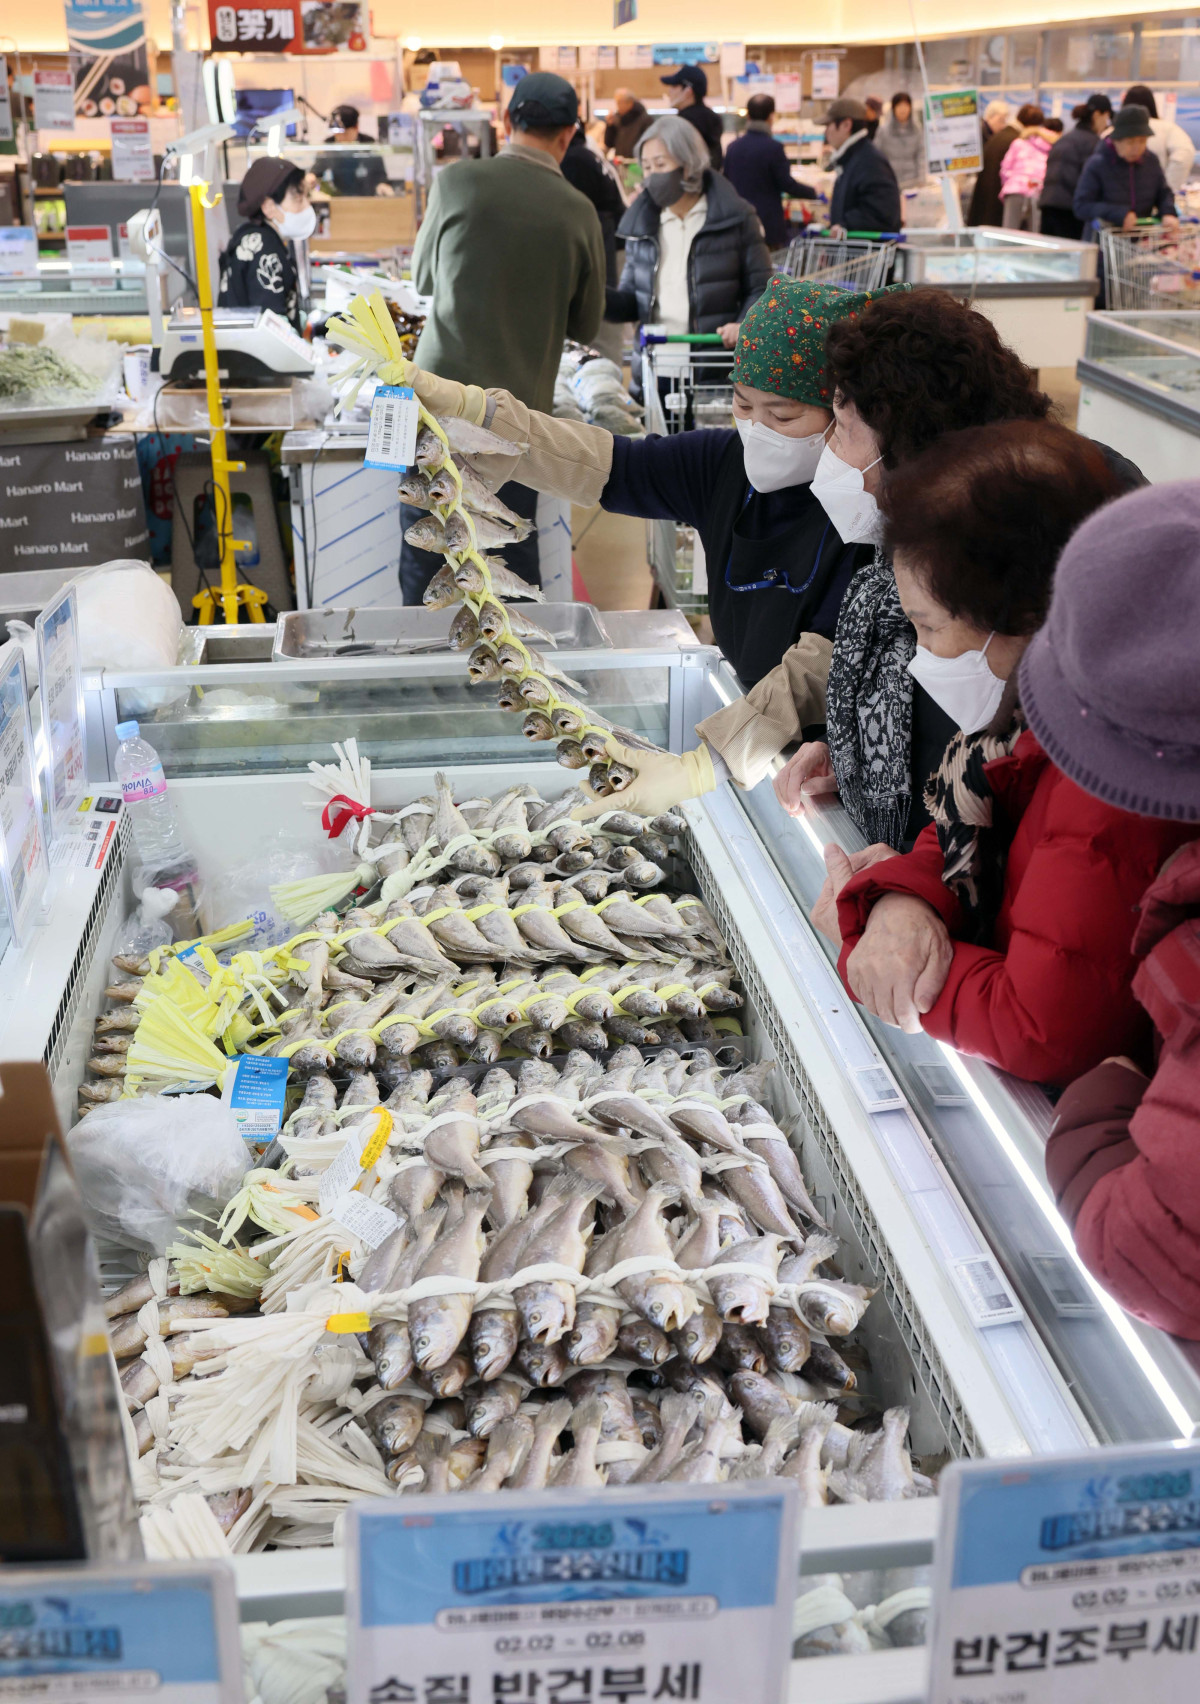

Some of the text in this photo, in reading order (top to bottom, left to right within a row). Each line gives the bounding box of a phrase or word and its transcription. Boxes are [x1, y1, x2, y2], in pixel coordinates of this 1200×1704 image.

[237, 8, 295, 41] 꽃게
[65, 450, 112, 463] Hanaro
[6, 481, 84, 498] Hanaro Mart
[71, 511, 116, 525] Hanaro
[14, 541, 89, 557] Hanaro Mart
[121, 777, 153, 793] 아이시스
[143, 785, 154, 796] 8.0
[531, 1521, 616, 1551] 2026
[494, 1635, 555, 1654] 02.02
[953, 1613, 1200, 1678] 반건조부세
[493, 1662, 701, 1704] 반건부세
